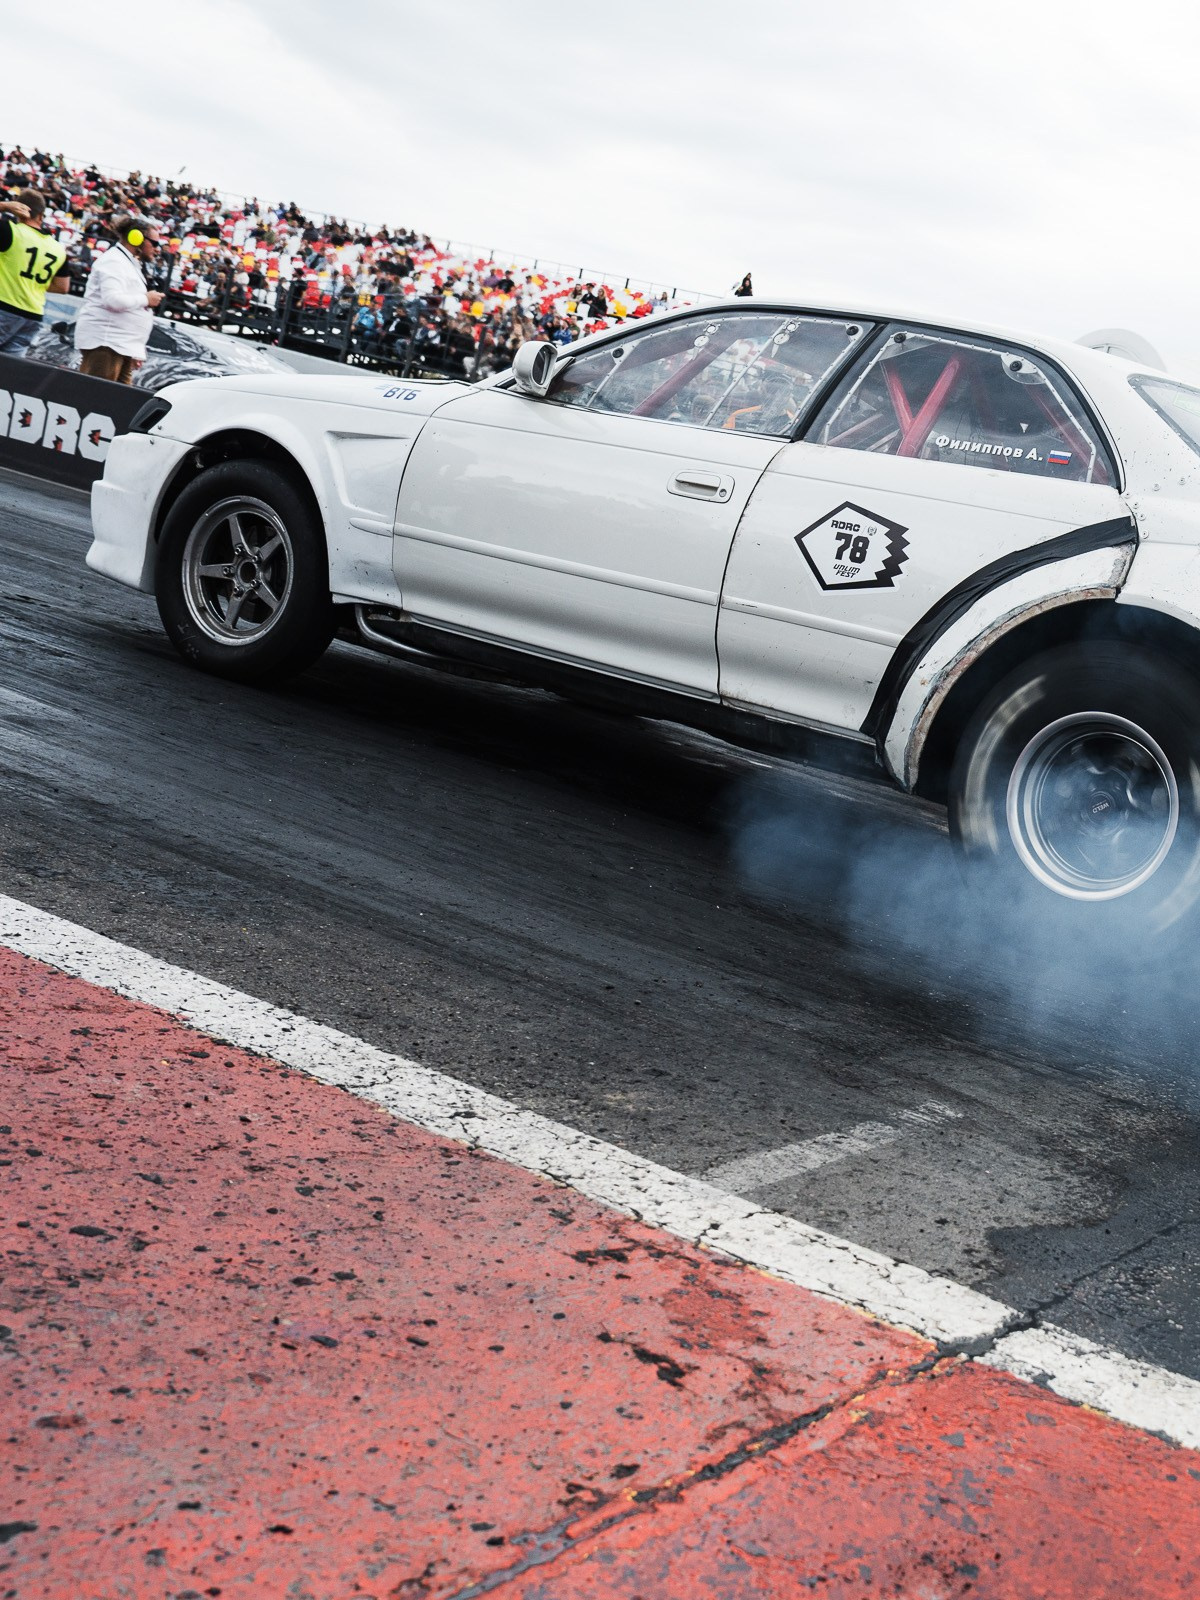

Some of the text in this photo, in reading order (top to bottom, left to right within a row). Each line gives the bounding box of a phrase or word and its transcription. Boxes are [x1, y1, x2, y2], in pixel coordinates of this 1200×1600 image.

[20, 247, 57, 284] 13
[383, 387, 421, 400] ВТБ
[935, 434, 1023, 458] Филиппов
[831, 520, 860, 532] RDRC
[835, 532, 870, 564] 78
[835, 570, 856, 578] FEST
